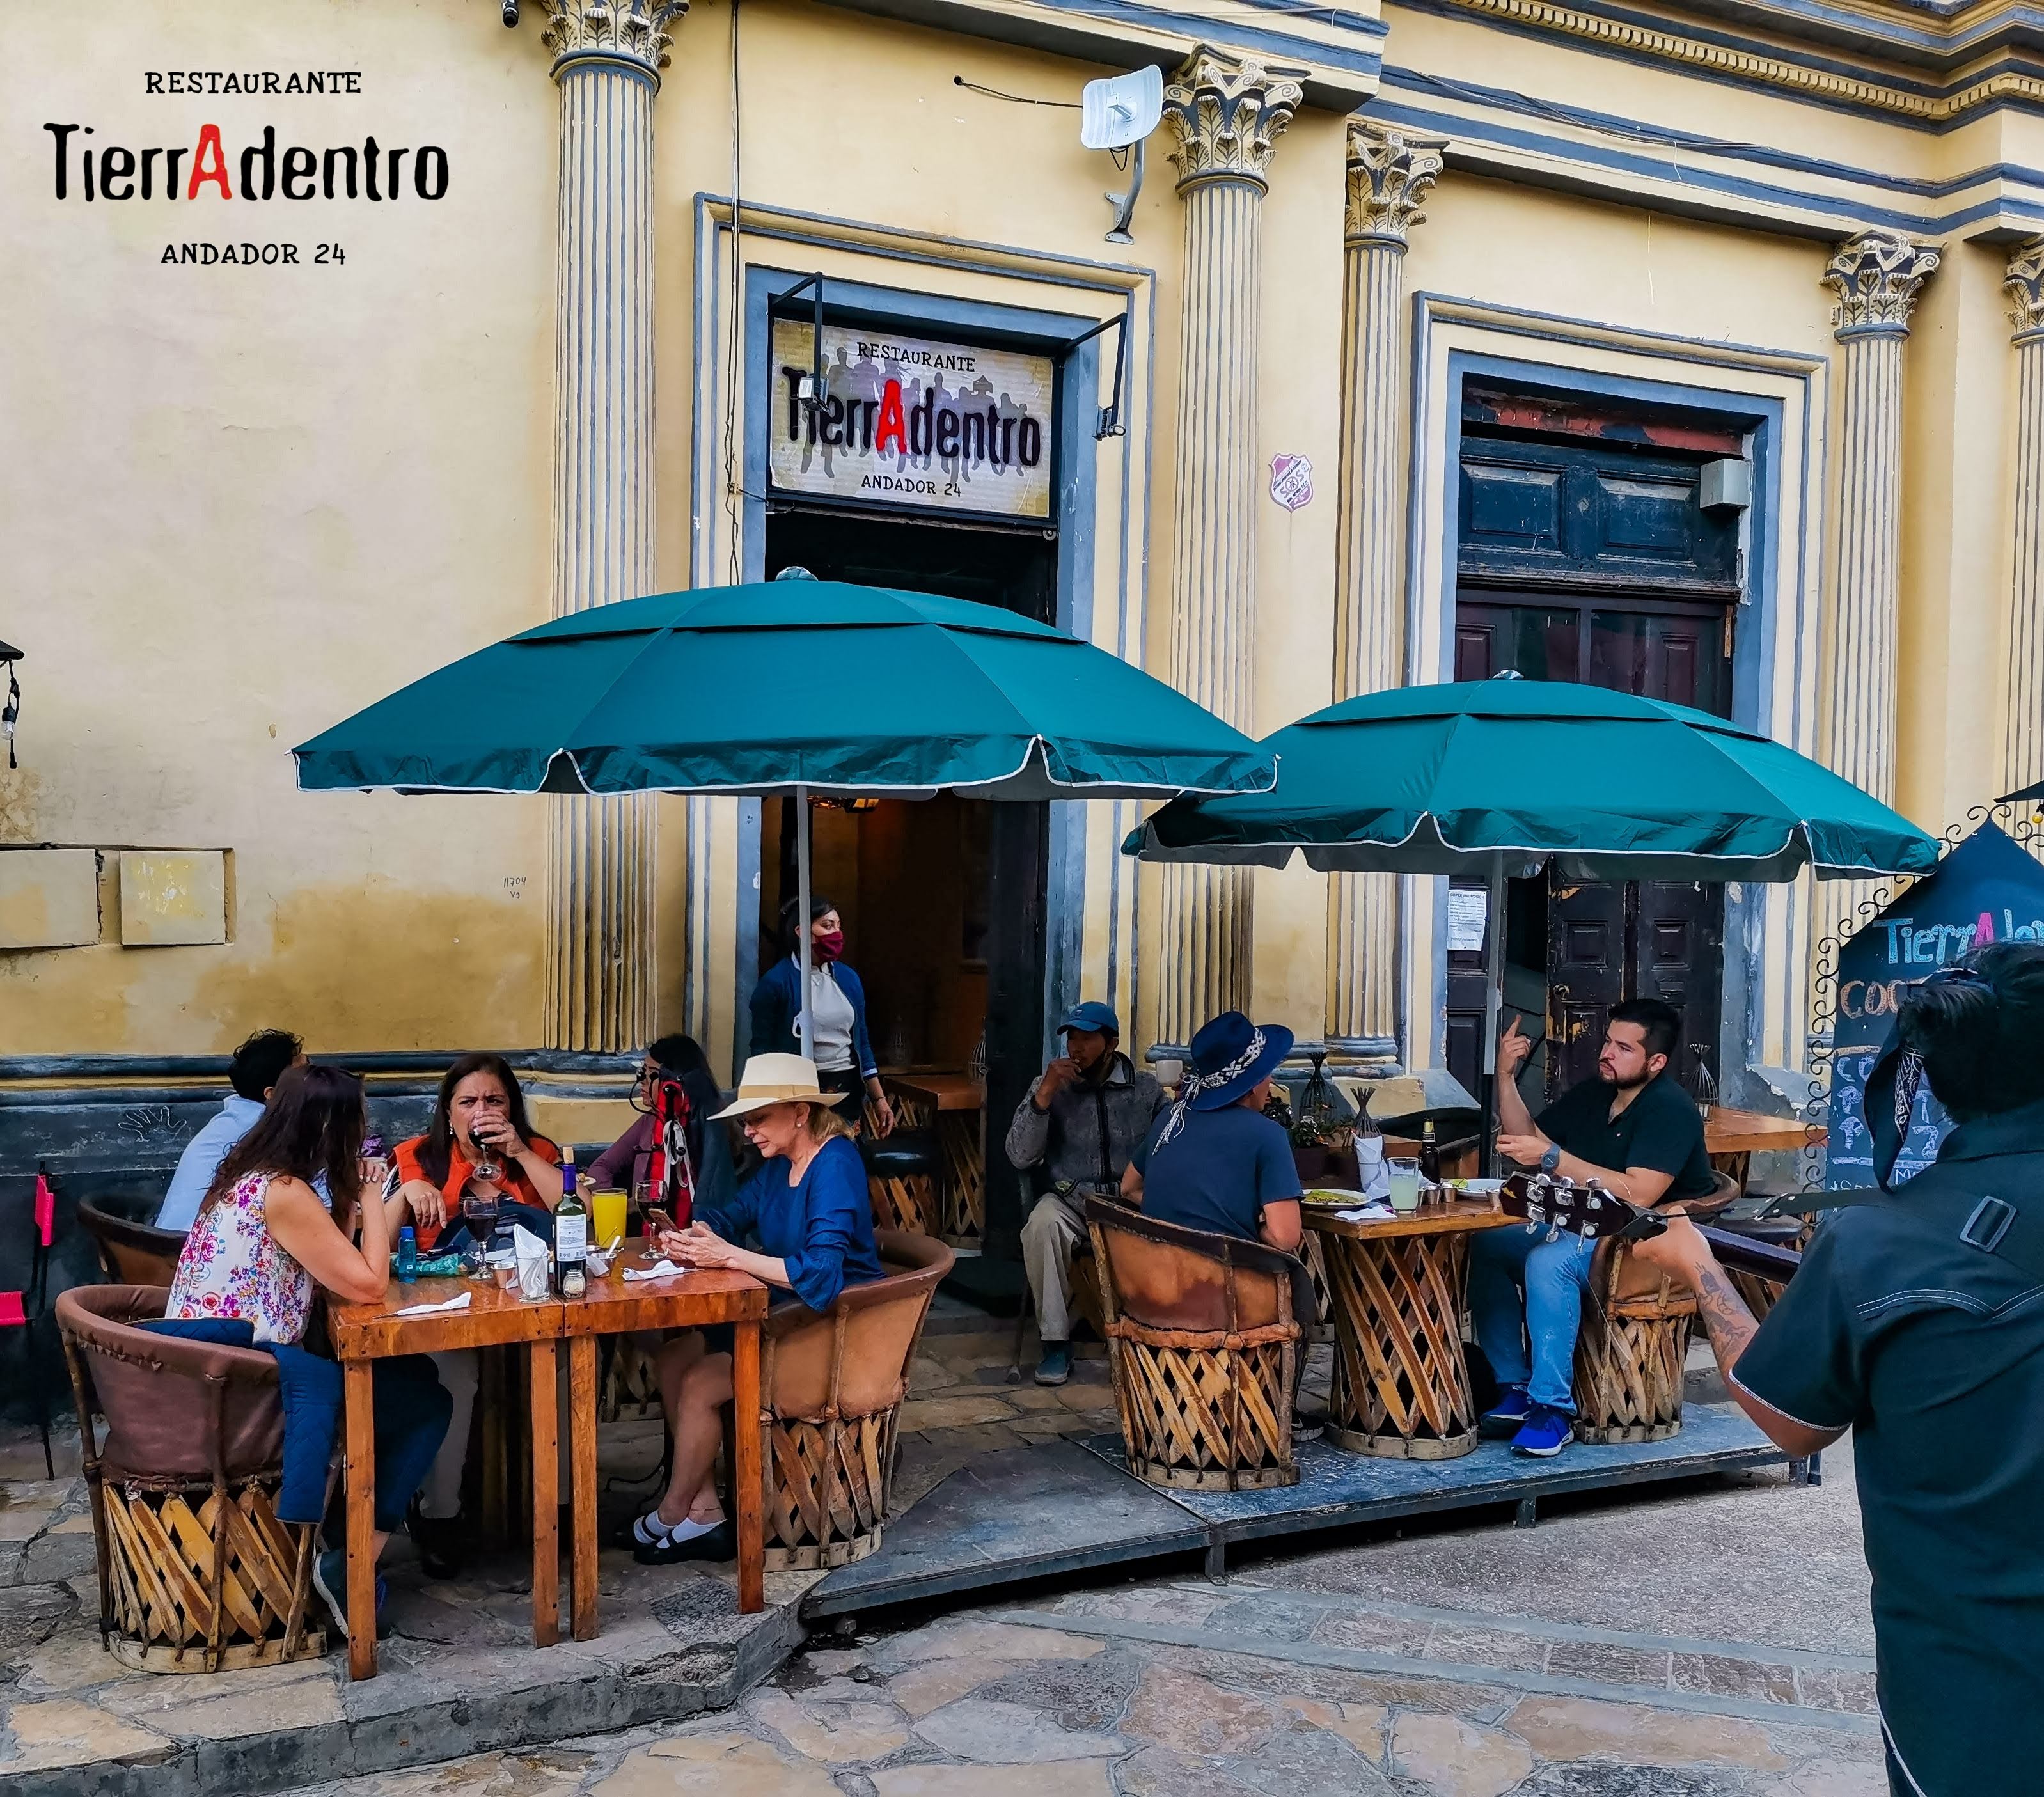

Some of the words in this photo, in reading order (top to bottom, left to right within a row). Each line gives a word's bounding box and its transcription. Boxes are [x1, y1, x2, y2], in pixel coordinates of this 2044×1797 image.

[856, 341, 976, 372] RESTAURANTE
[861, 475, 936, 495] ANDADOR
[944, 482, 961, 498] 24
